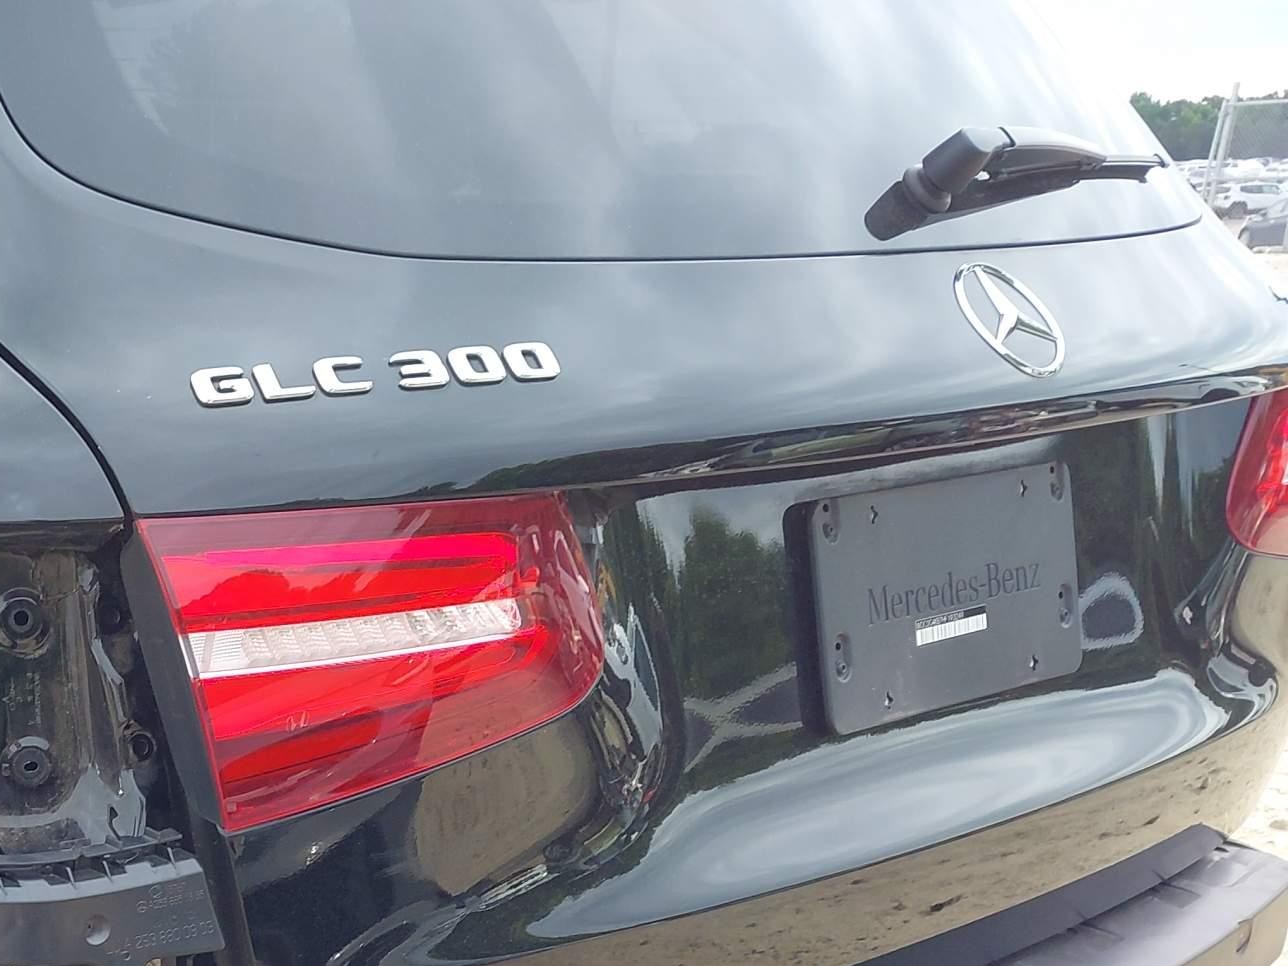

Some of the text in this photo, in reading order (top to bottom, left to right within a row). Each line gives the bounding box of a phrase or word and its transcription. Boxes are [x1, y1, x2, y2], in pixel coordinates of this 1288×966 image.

[190, 341, 562, 408] GLC 300
[867, 561, 1042, 625] Mercedes-Benz
